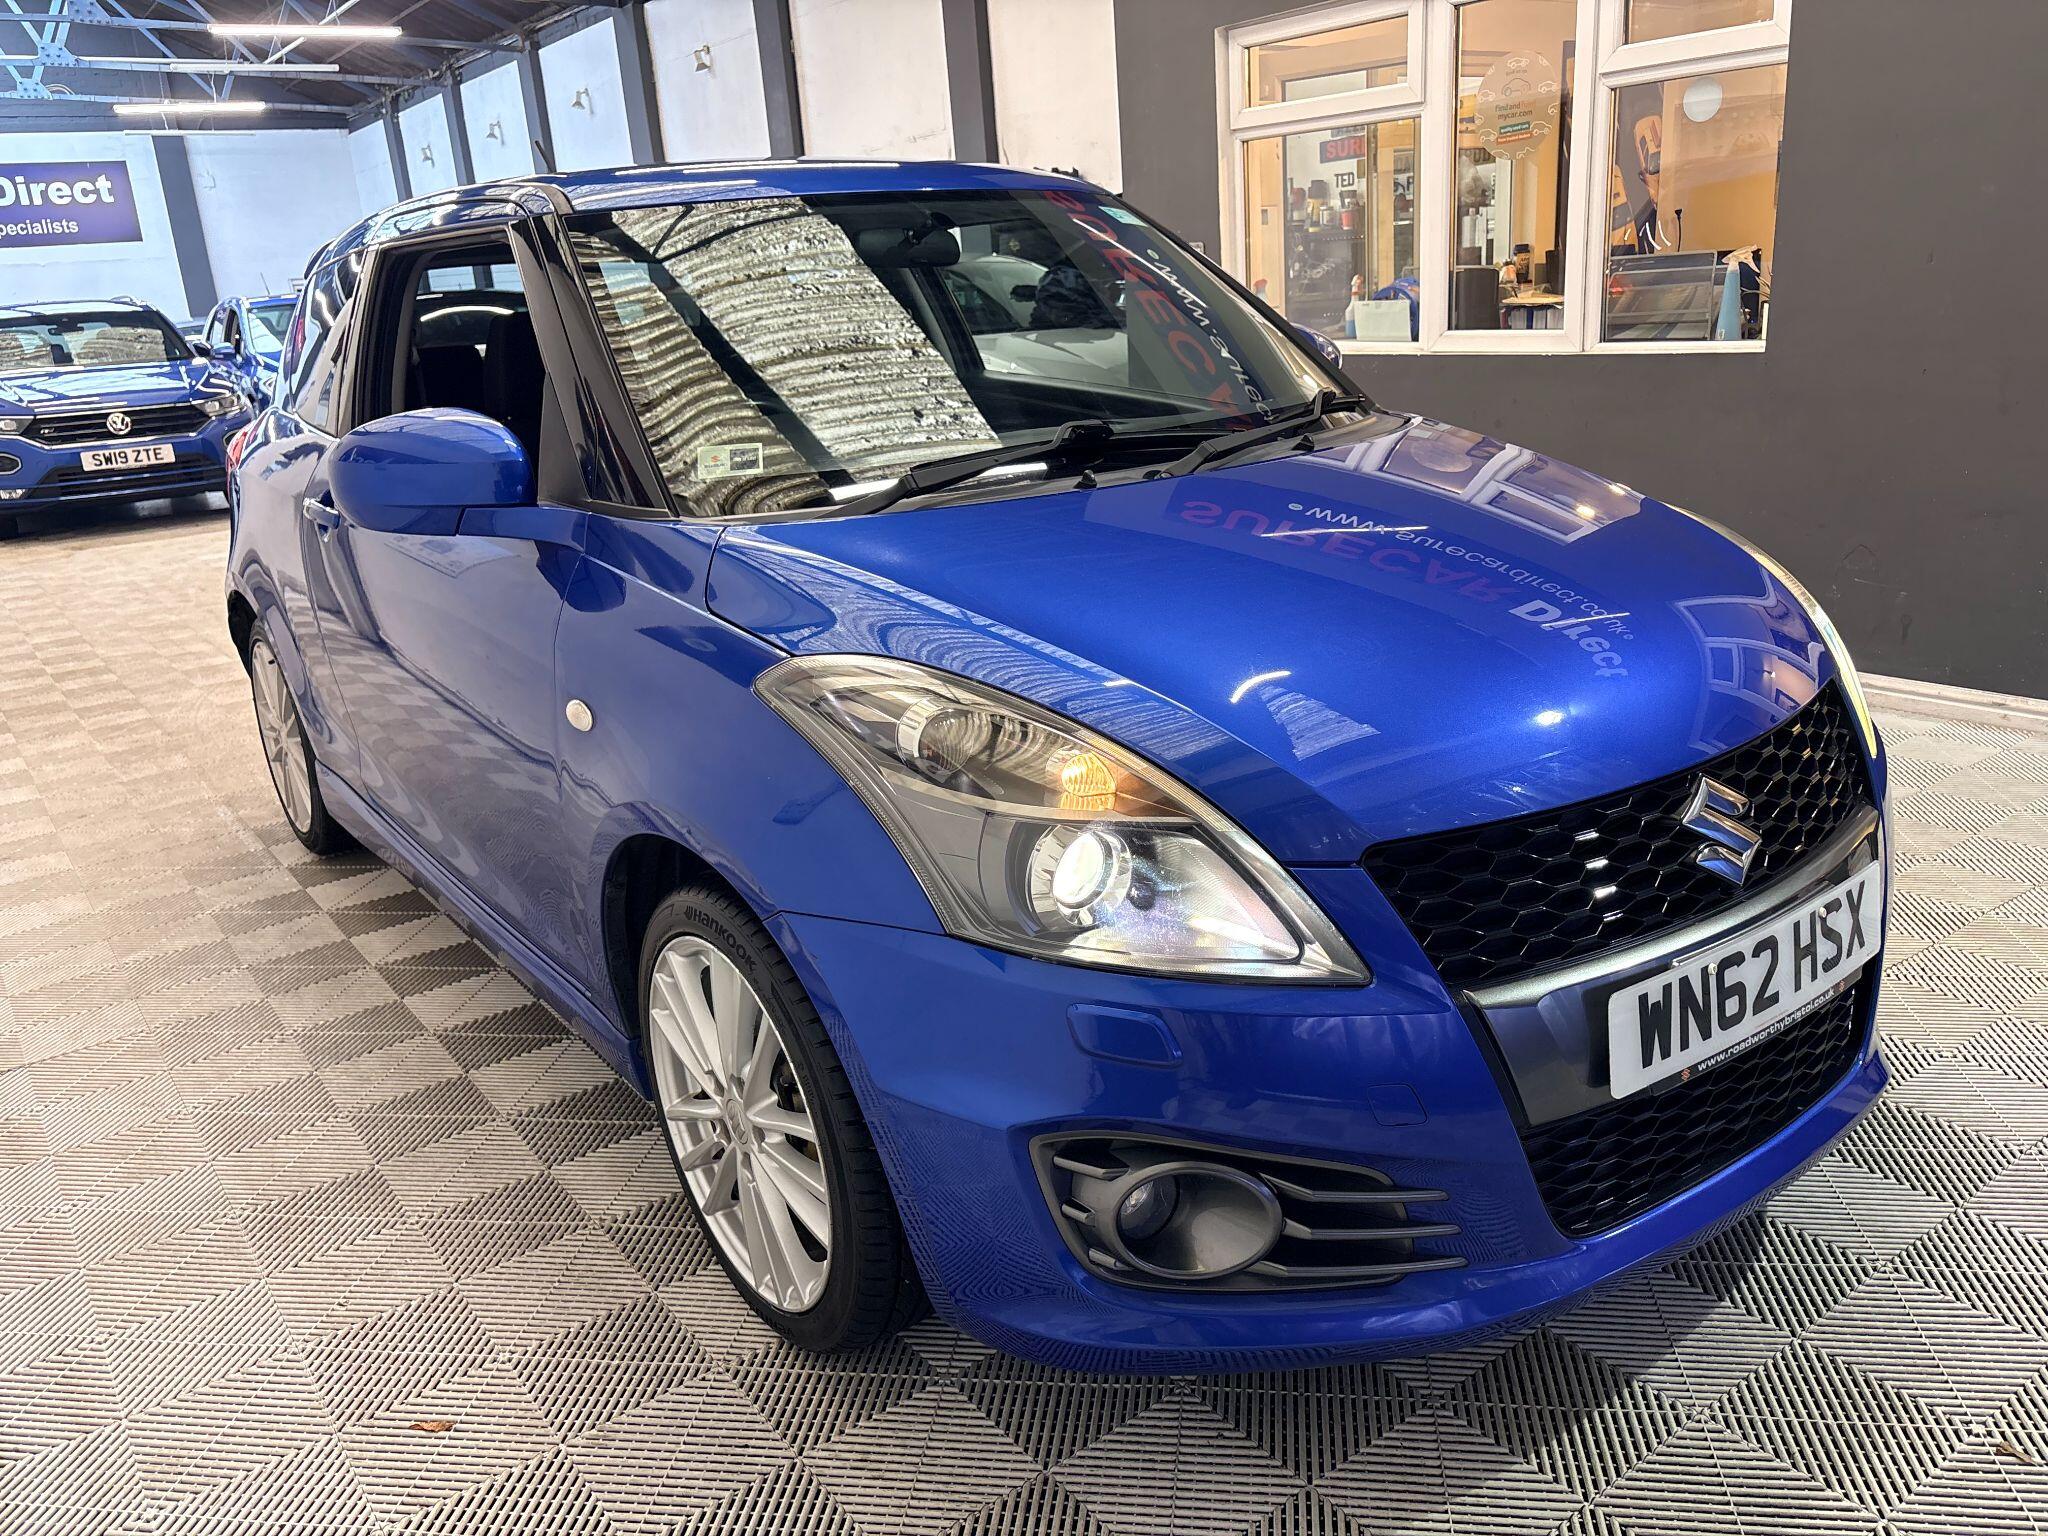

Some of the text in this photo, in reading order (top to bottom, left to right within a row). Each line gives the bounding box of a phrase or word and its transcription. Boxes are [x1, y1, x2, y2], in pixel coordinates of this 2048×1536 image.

[1334, 172, 1355, 188] TED
[92, 447, 164, 467] SW19 ZTE
[1637, 880, 1866, 1069] WN62 HSX
[1697, 987, 1835, 1071] www.roadworthybristol.co.uk
